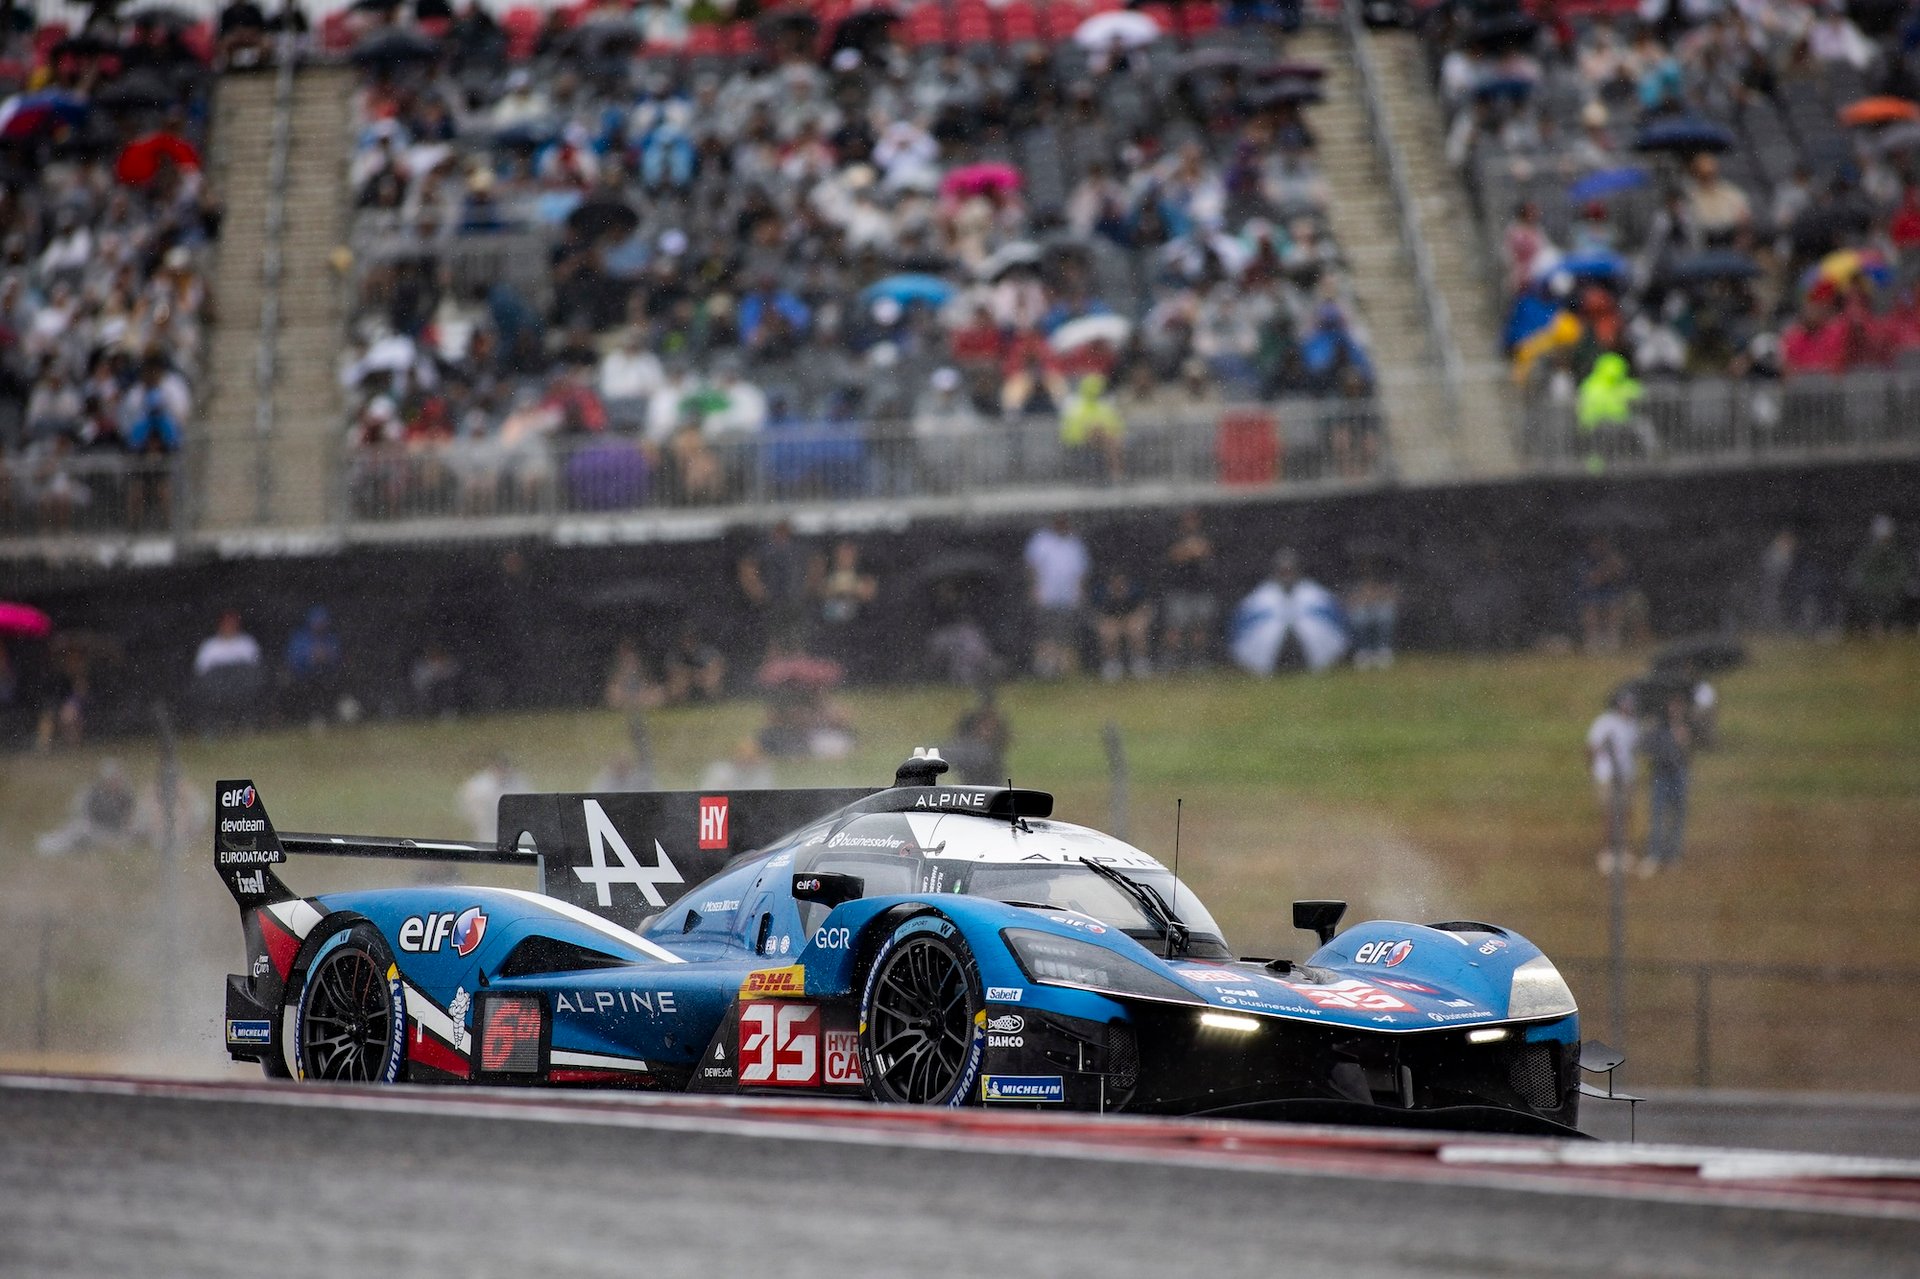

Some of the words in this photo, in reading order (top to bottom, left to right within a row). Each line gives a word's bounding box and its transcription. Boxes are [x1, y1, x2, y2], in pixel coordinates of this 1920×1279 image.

[915, 793, 986, 807] ALPINE
[221, 817, 265, 833] devoteam
[701, 805, 727, 841] HY
[841, 833, 905, 849] businessolver
[220, 850, 279, 864] EURODATACAR
[235, 869, 266, 894] ixell
[796, 880, 812, 891] elf
[399, 913, 455, 952] elf
[940, 922, 951, 935] W
[815, 927, 851, 950] GCR
[1355, 941, 1393, 964] elf
[749, 972, 797, 991] DHL
[556, 991, 677, 1014] ALPINE
[988, 988, 1019, 1001] Sabelt
[1239, 998, 1323, 1016] businessolver
[237, 1028, 270, 1037] MICHELIN
[386, 995, 404, 1084] MICHELIN
[740, 1004, 818, 1082] 35
[987, 1035, 1024, 1048] BAHCO
[704, 1067, 733, 1079] DEWESoft
[1001, 1084, 1061, 1095] MICHELIN
